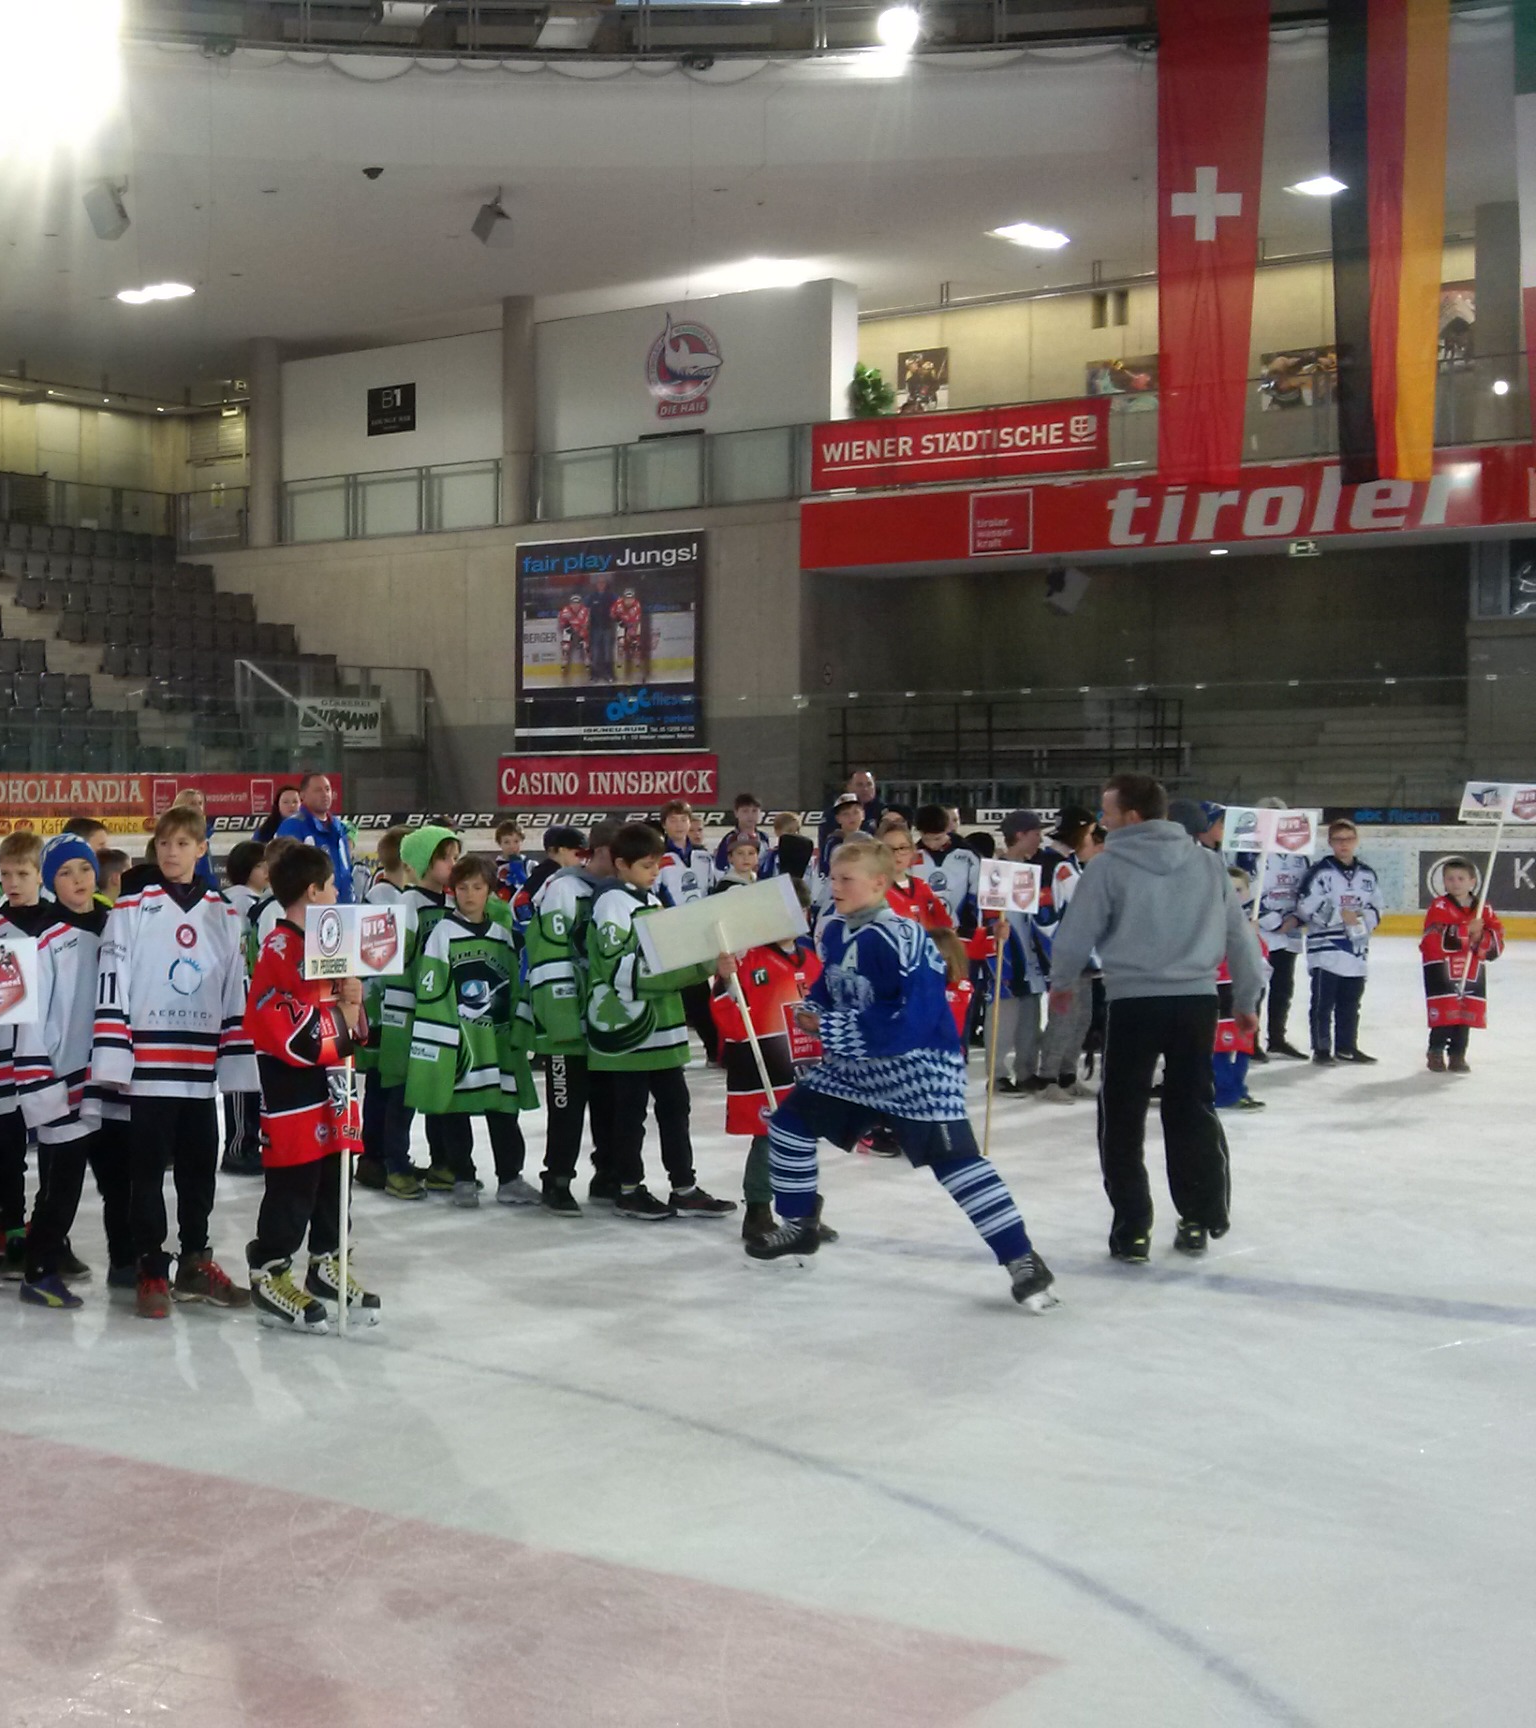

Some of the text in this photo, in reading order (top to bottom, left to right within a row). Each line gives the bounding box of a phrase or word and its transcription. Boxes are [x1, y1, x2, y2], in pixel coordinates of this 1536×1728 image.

[822, 423, 1064, 463] WIENER STÄDTISCHE
[1107, 466, 1482, 546] tiroler
[523, 543, 697, 573] fair play Jungs!
[588, 769, 714, 795] INNSBRUCK
[552, 913, 566, 936] 6
[100, 972, 116, 1004] 11
[421, 969, 435, 993] 4
